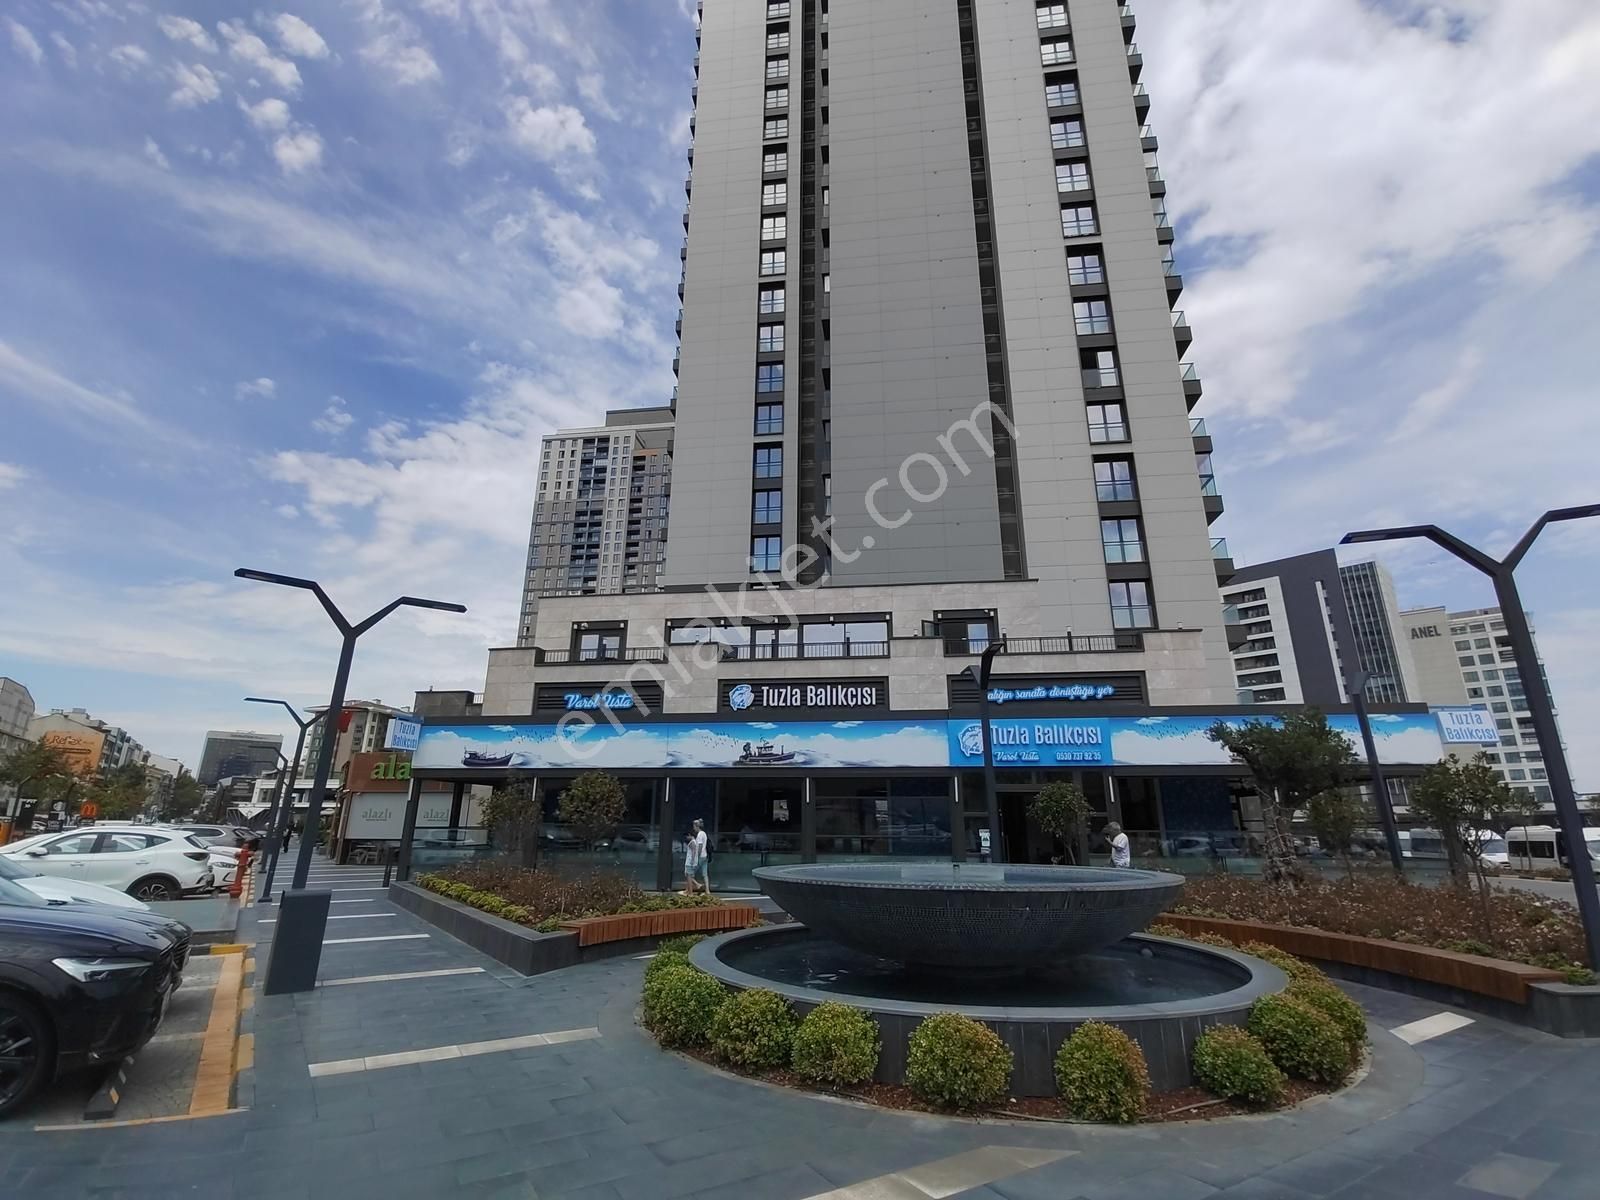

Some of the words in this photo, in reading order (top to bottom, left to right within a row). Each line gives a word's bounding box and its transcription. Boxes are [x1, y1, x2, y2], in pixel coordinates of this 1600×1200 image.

[1411, 625, 1442, 640] ANEL
[761, 685, 800, 707] Tuzla
[807, 684, 876, 708] Balıkçısı
[1096, 684, 1115, 699] yer
[564, 693, 601, 709] Varol
[602, 693, 634, 708] Usta
[1447, 712, 1483, 725] Tuzla
[399, 721, 416, 735] Tuzla
[990, 724, 1030, 745] Tuzla
[1034, 724, 1103, 747] Balıkçısı
[994, 750, 1019, 761] Varol
[1020, 750, 1040, 761] Usta
[1056, 752, 1072, 761] 0530
[370, 754, 411, 780] ala
[423, 808, 450, 819] alazl
